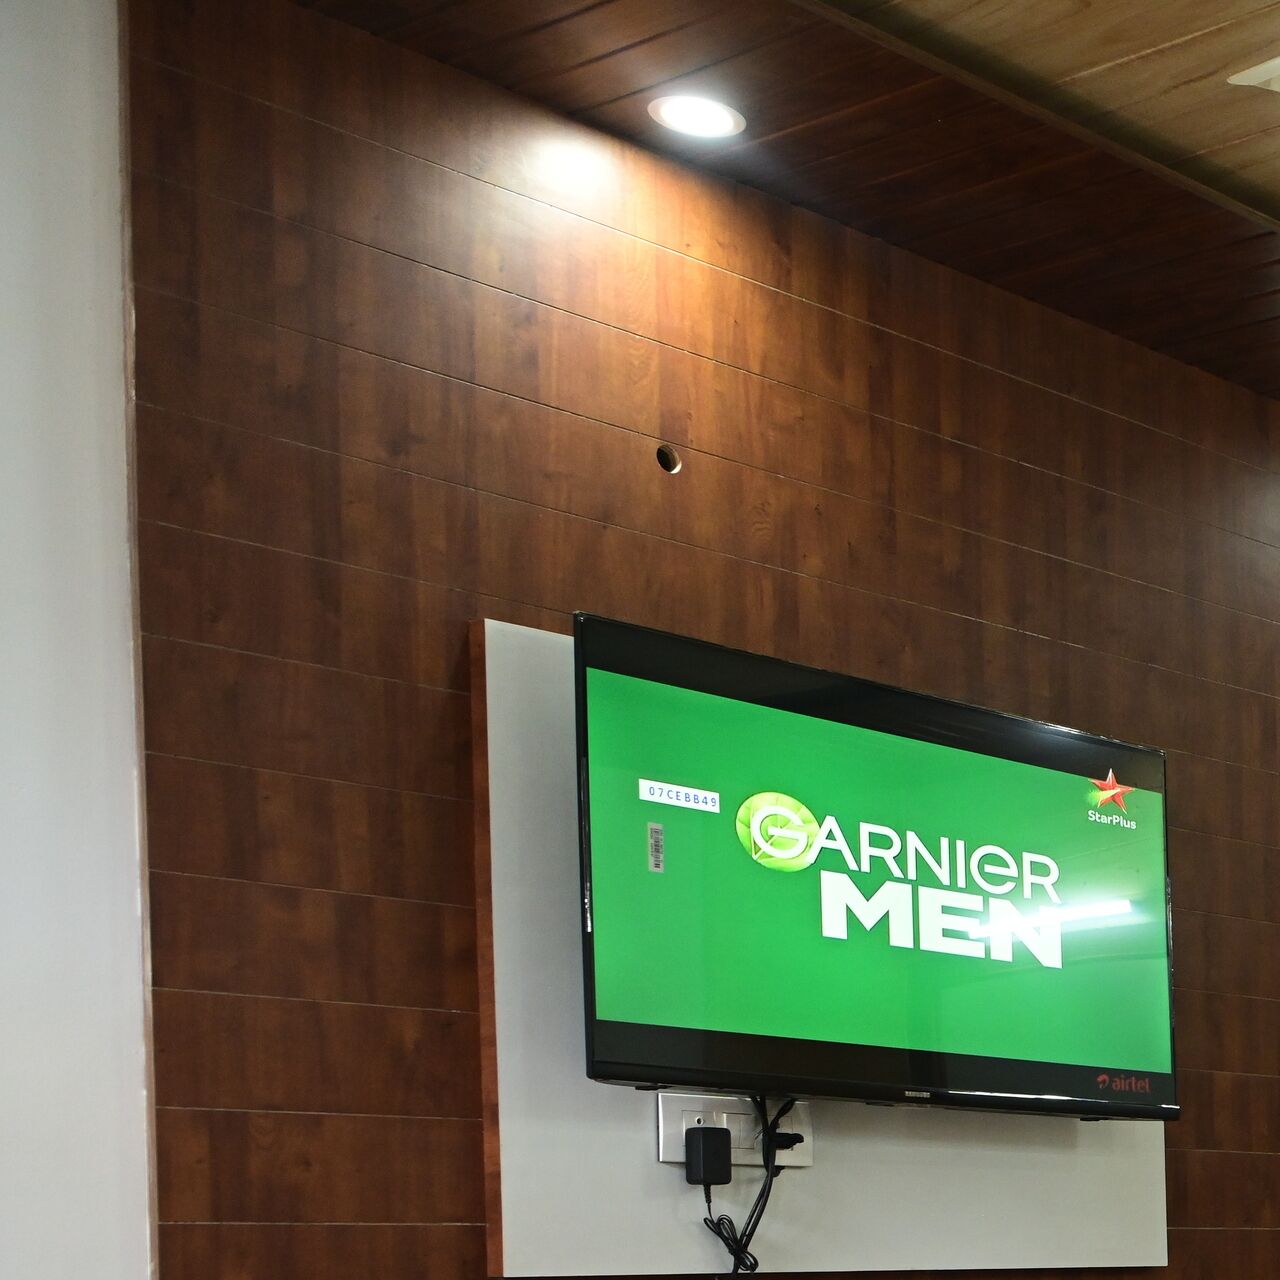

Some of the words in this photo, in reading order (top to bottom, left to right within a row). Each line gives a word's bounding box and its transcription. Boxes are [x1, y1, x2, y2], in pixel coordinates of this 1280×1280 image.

[649, 786, 717, 807] 07CEBB49
[1088, 809, 1137, 830] StarPlus
[749, 805, 1062, 904] GARNIER
[820, 869, 1063, 969] MEN
[1111, 1074, 1152, 1094] airtel
